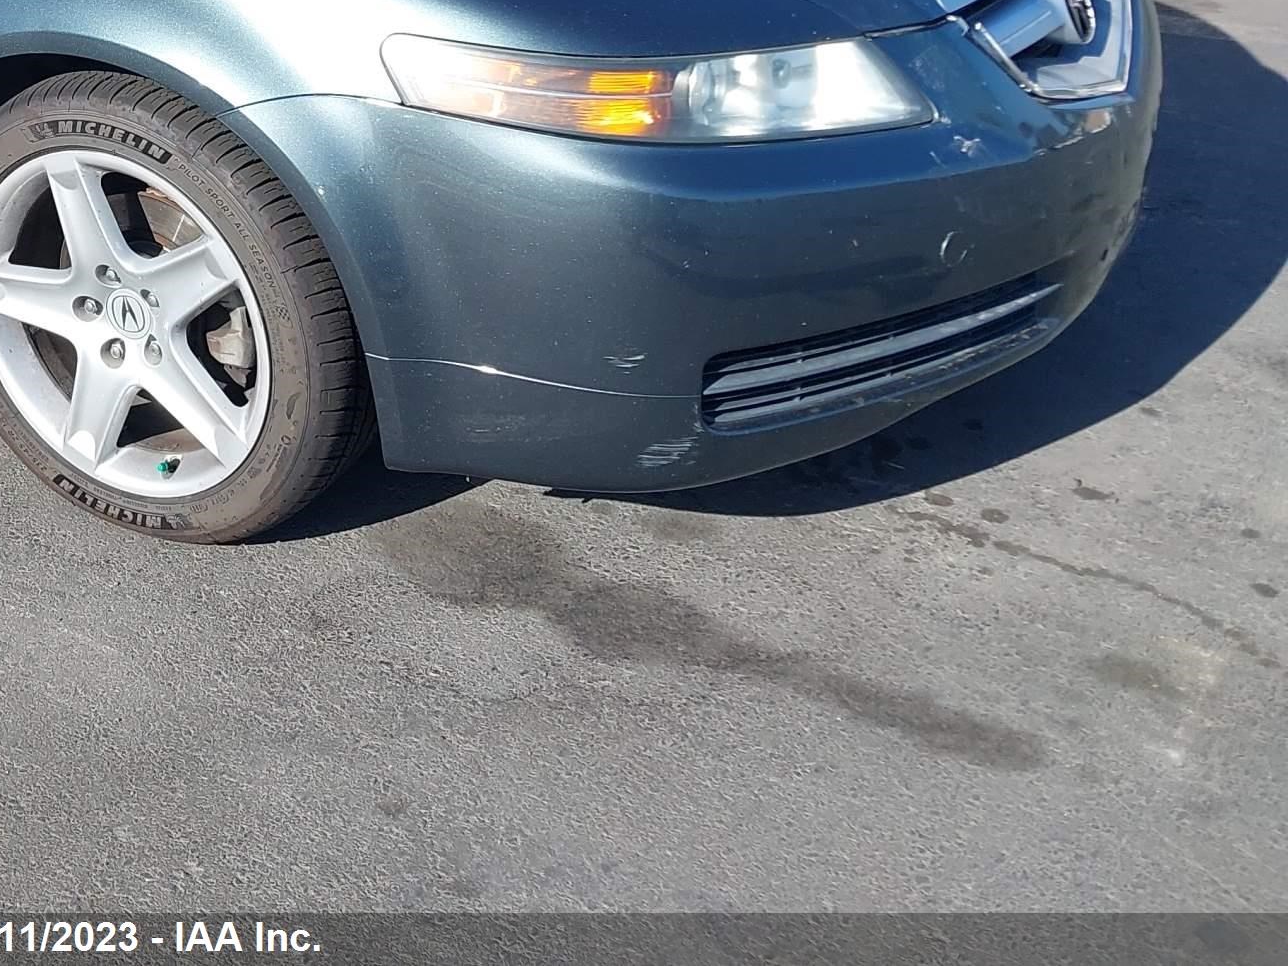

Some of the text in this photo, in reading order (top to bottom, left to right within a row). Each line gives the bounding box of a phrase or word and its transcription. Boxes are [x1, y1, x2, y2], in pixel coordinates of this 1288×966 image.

[57, 120, 166, 160] MICHELIN
[178, 163, 205, 187] PILOT
[205, 187, 235, 218] SPORT
[234, 221, 249, 241] ALL
[249, 244, 276, 289] SEASON
[58, 477, 162, 529] MICHELIN
